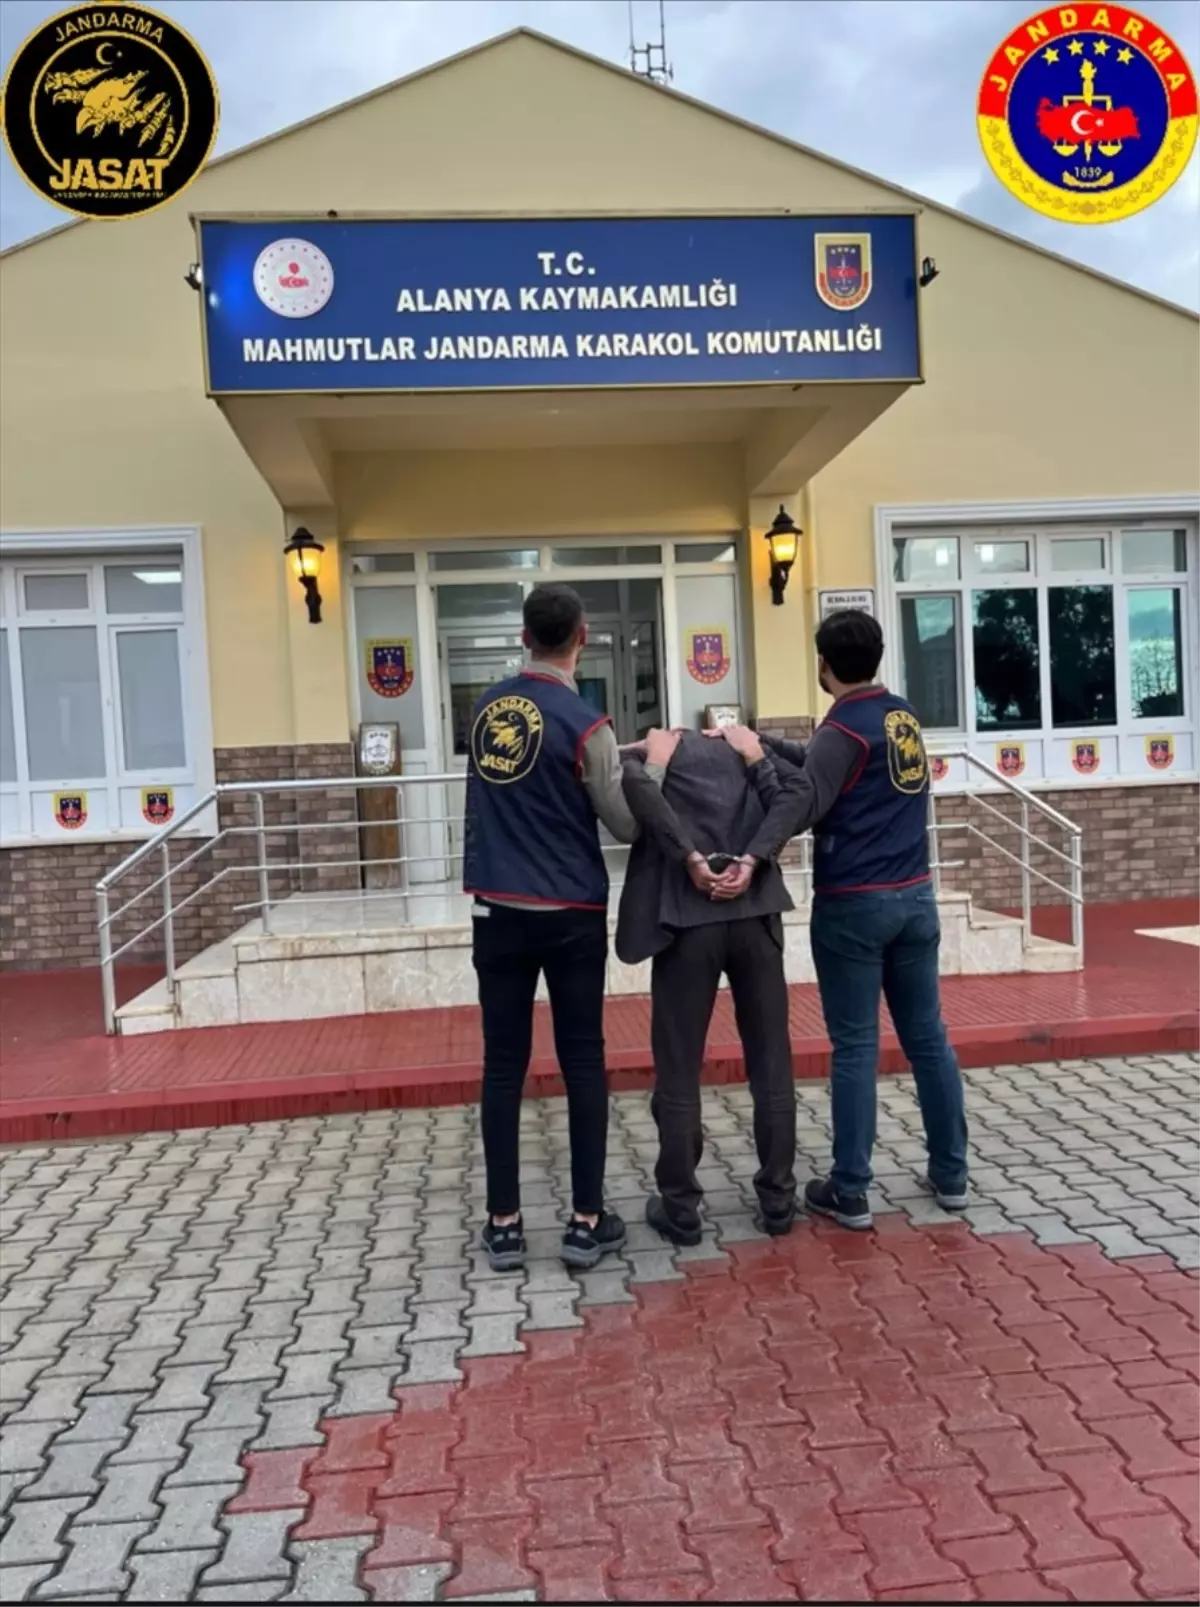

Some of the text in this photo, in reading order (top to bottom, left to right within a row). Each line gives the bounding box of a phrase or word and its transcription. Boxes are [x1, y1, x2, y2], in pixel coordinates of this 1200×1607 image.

[397, 278, 737, 312] ALANYA KAYMAKAMLIĞI
[243, 323, 882, 362] MAHMUTLAR JANDARMA KARAKOL KOMUTANLIĞI
